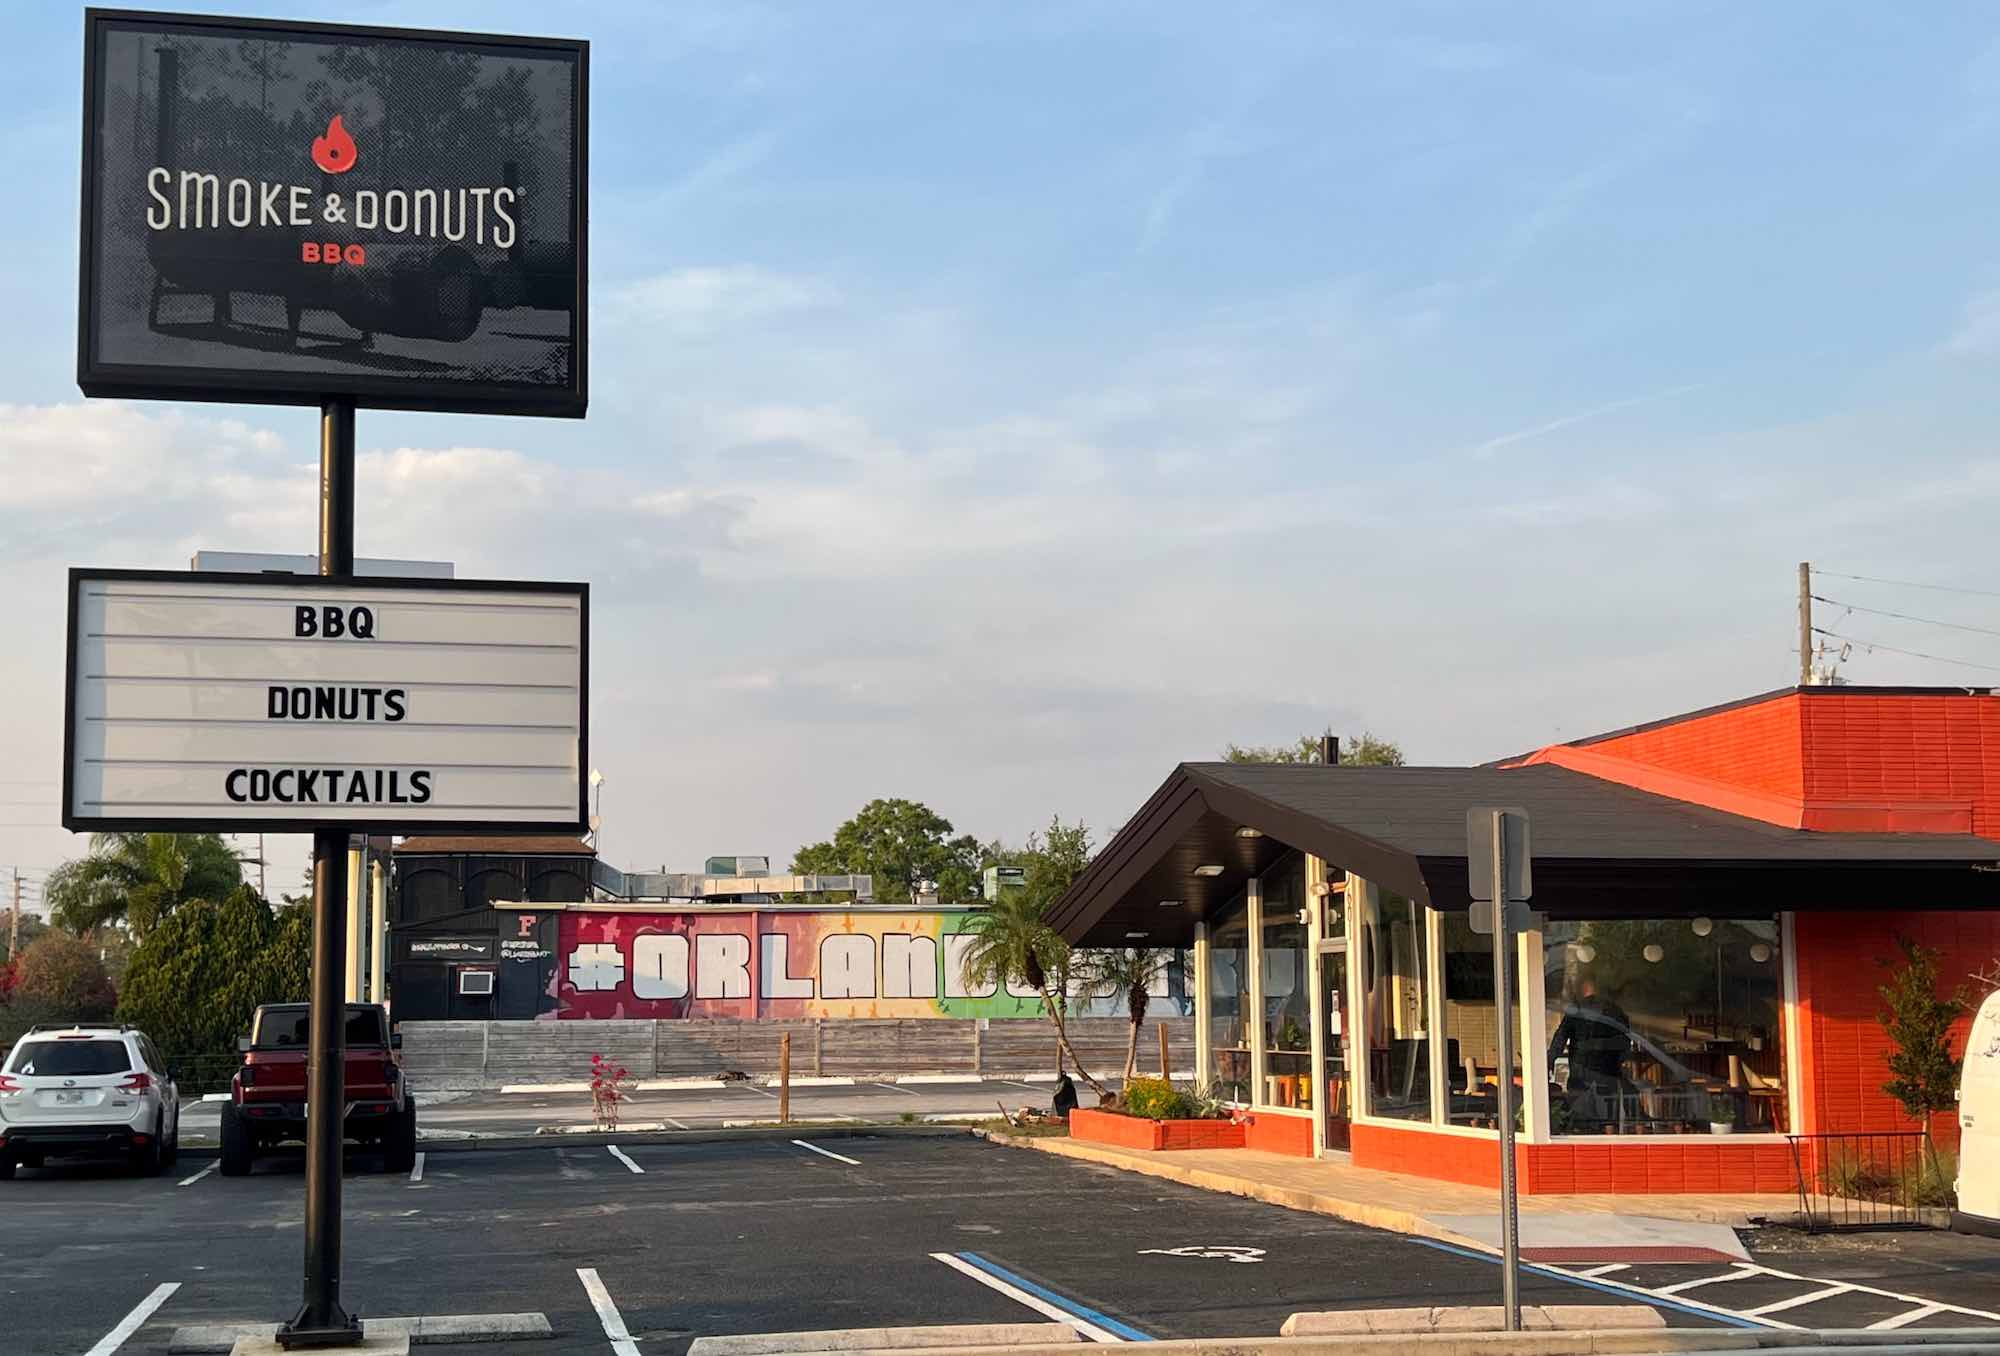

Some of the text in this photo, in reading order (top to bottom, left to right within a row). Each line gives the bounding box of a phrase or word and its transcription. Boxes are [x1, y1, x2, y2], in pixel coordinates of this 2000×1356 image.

[147, 167, 516, 249] SMOKE & DONUTS
[302, 242, 366, 266] BBQ
[295, 606, 375, 640] BBQ
[267, 686, 406, 722] DONUTS
[225, 769, 432, 804] COCKTAILS
